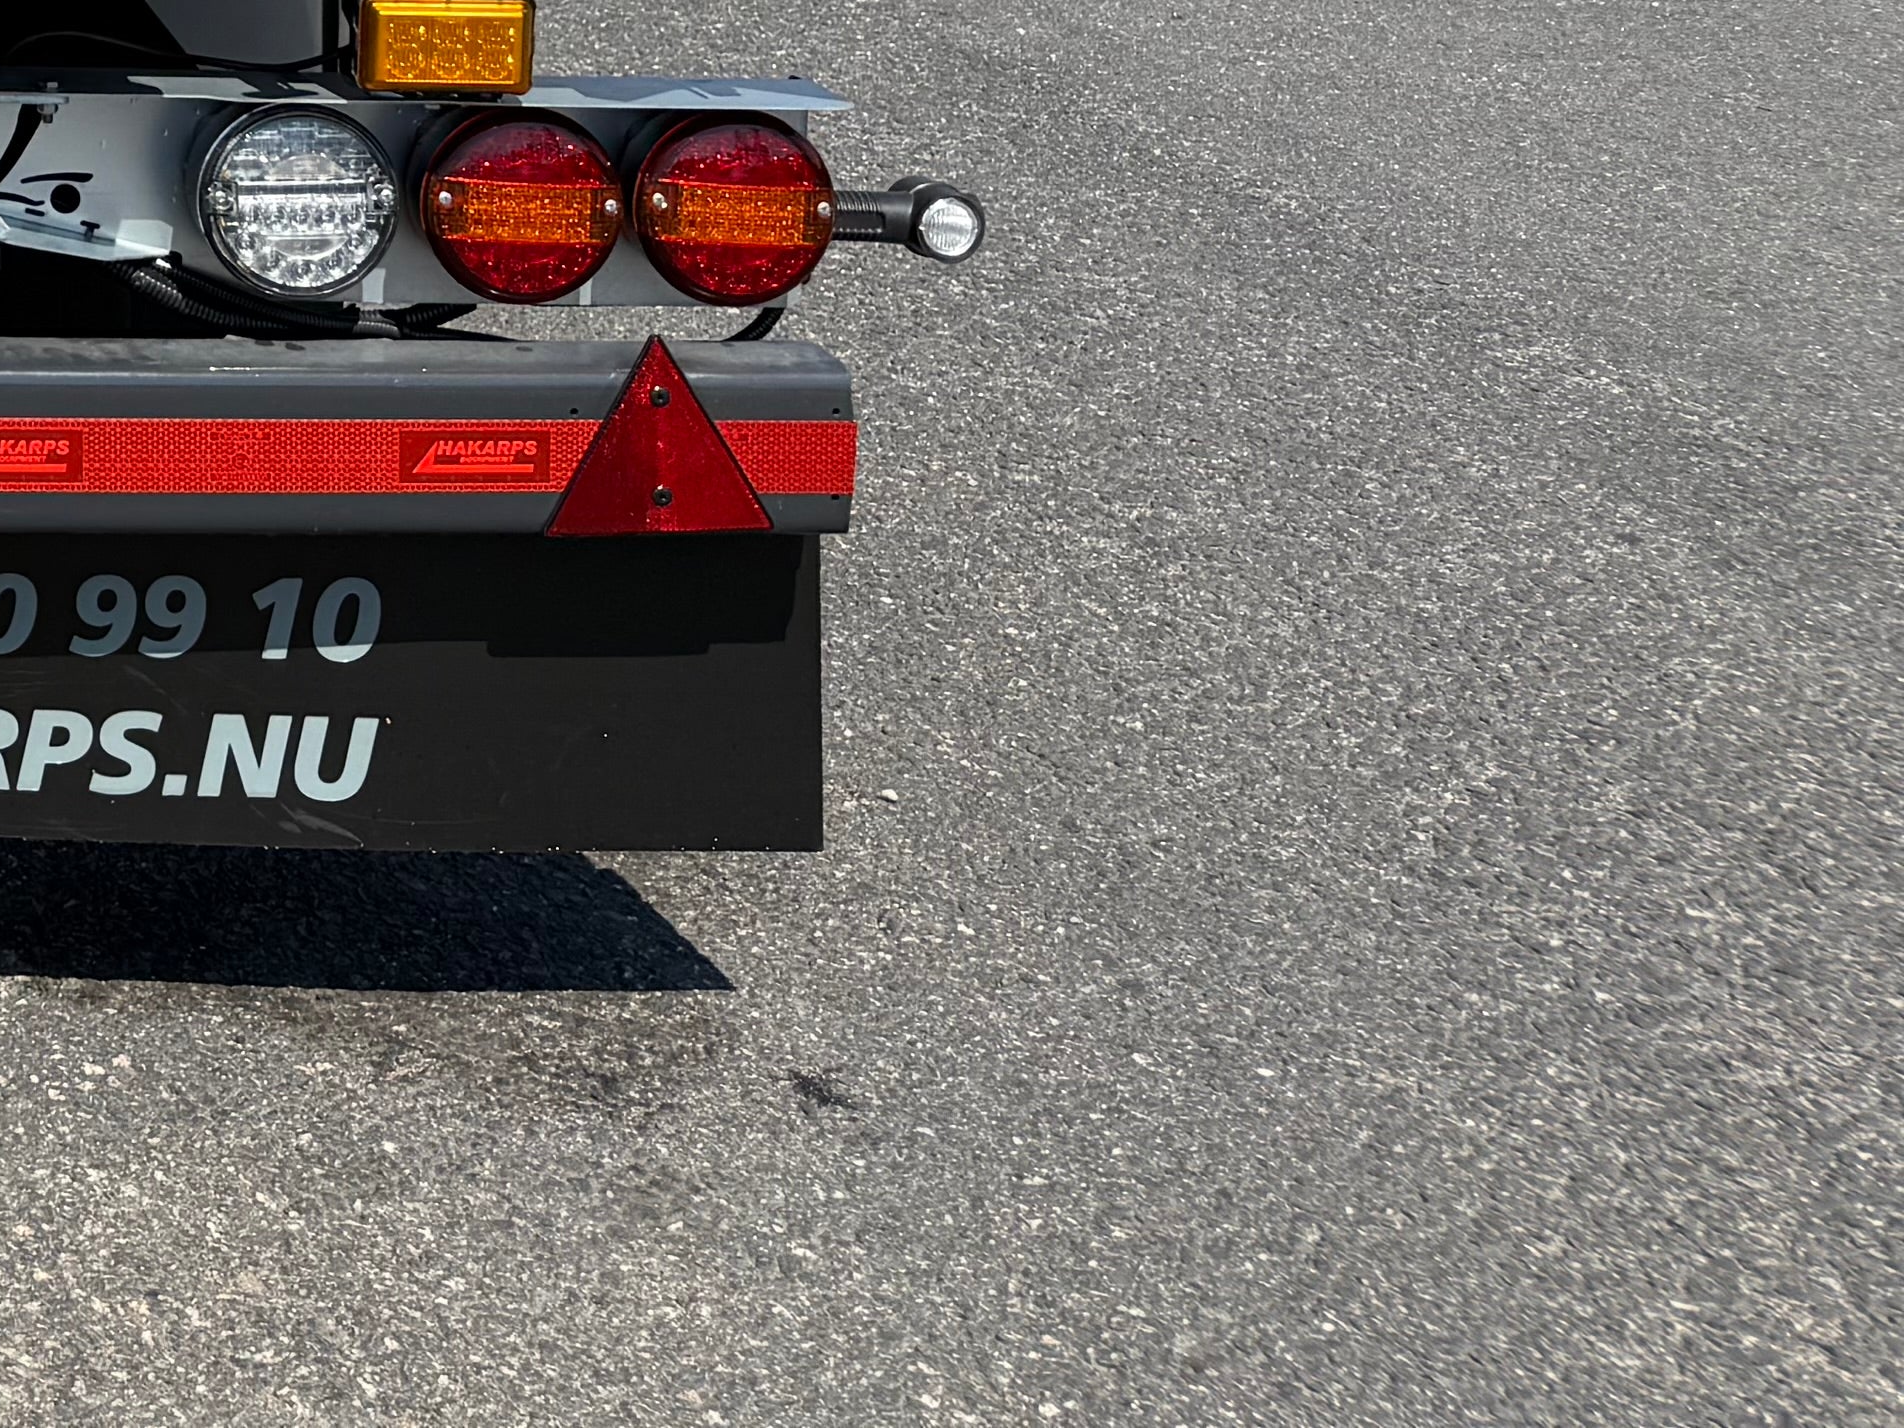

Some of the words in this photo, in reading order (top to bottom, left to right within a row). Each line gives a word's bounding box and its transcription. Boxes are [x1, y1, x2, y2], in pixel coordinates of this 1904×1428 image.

[437, 440, 538, 456] HAKARPS
[69, 574, 208, 659] 99
[251, 577, 383, 663] 10
